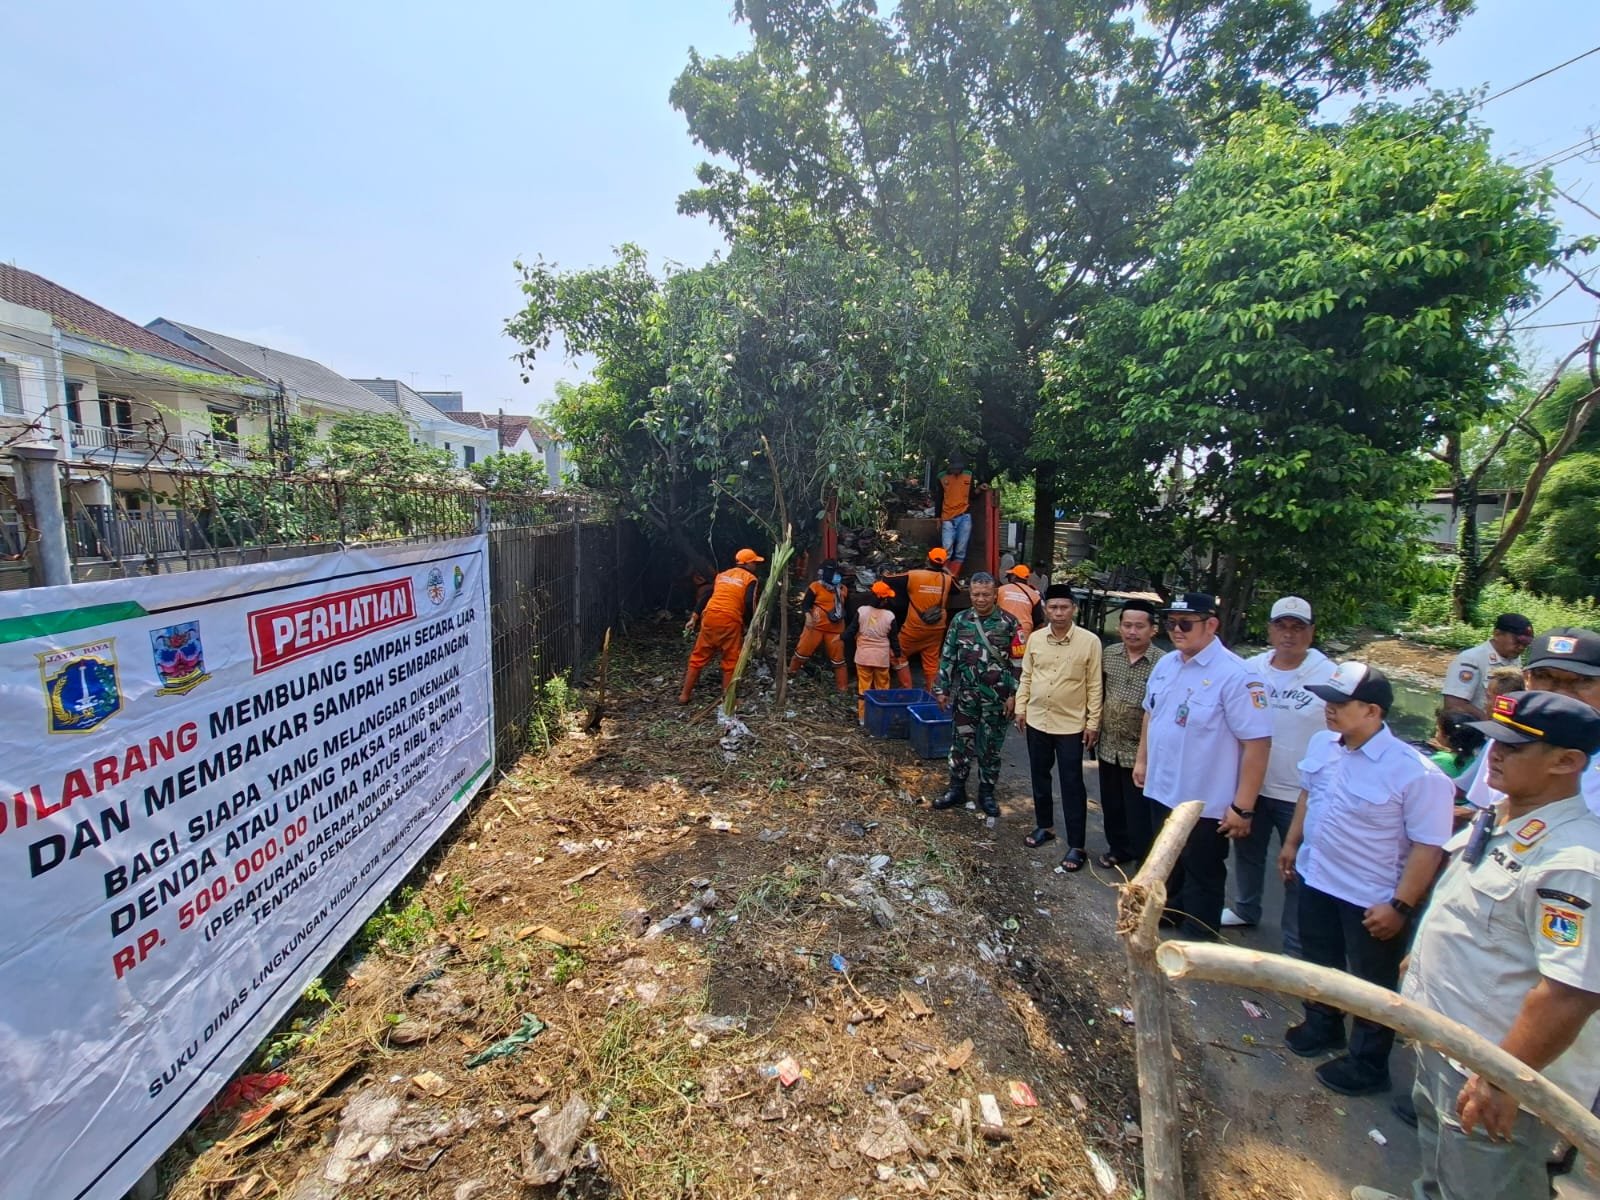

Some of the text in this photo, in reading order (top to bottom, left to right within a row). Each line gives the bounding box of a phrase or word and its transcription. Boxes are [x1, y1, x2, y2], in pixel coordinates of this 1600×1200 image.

[0, 608, 475, 835] ILARANG MEMBUANG SAMPAH SECARA LIAR
[47, 643, 109, 663] JAYA RAYA
[272, 587, 407, 656] PERHATIAN
[28, 632, 470, 878] DAN MEMBAKAR SAMPAH SEMBARANGAN
[104, 664, 460, 899] BAGI SIAPA YANG MELANGGAR DIKENAKAN
[110, 684, 461, 938] DENDA ATAU UANG PAKSA PALING BANYAK
[112, 702, 462, 980] RP. 500.000,00 (LIMA RATUS RIBU RUPIAH)
[204, 848, 304, 942] (PERATURAN
[307, 808, 354, 856] DAERAH
[357, 782, 391, 815] NOMOR
[393, 773, 399, 784] 3
[401, 753, 426, 776] TAHUN
[251, 861, 317, 925] TENTANG
[320, 794, 394, 866] PENGELOLAAN
[149, 1040, 198, 1098] SUKU
[203, 987, 249, 1043] DINAS
[252, 909, 328, 991] LINGKUNGAN
[330, 876, 357, 910] HIDUP
[360, 857, 380, 878] KOTA
[382, 807, 427, 856] ADMINISTRASI
[428, 787, 450, 810] JAKARTA
